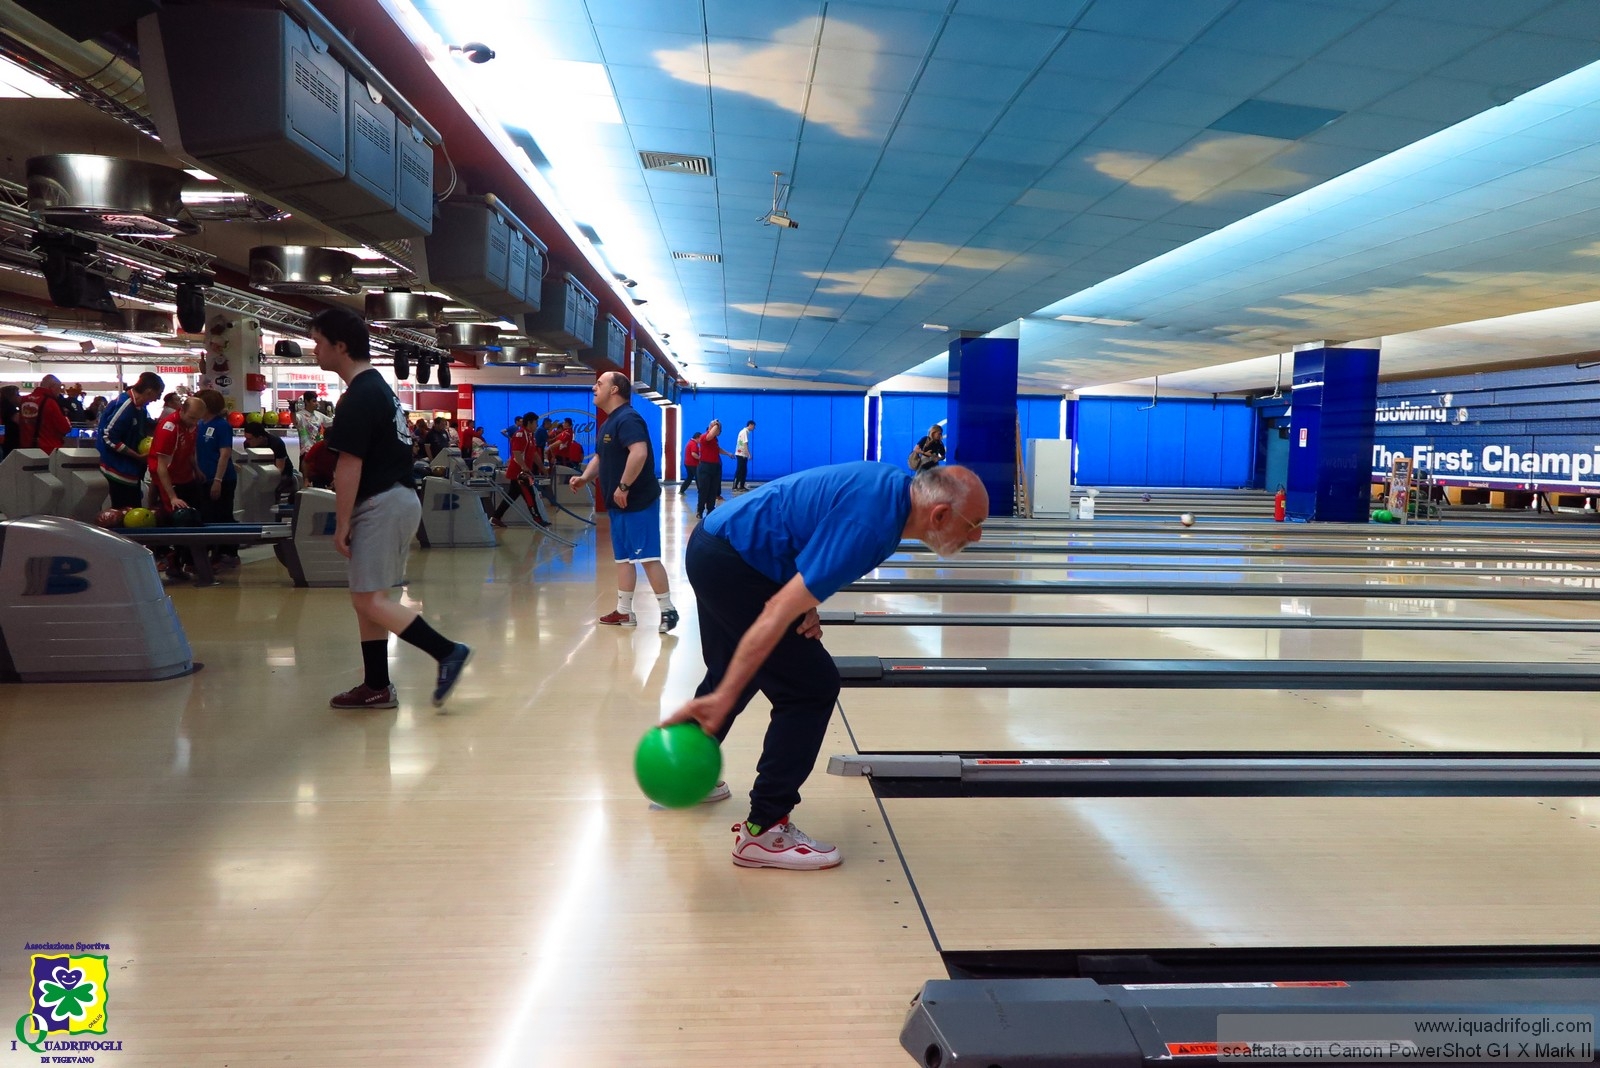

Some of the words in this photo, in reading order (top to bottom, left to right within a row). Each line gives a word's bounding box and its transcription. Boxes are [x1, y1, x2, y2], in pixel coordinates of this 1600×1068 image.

[291, 373, 326, 382] TERRYBELL
[1413, 444, 1474, 470] First
[1482, 445, 1600, 482] Champi
[1524, 482, 1530, 490] 6
